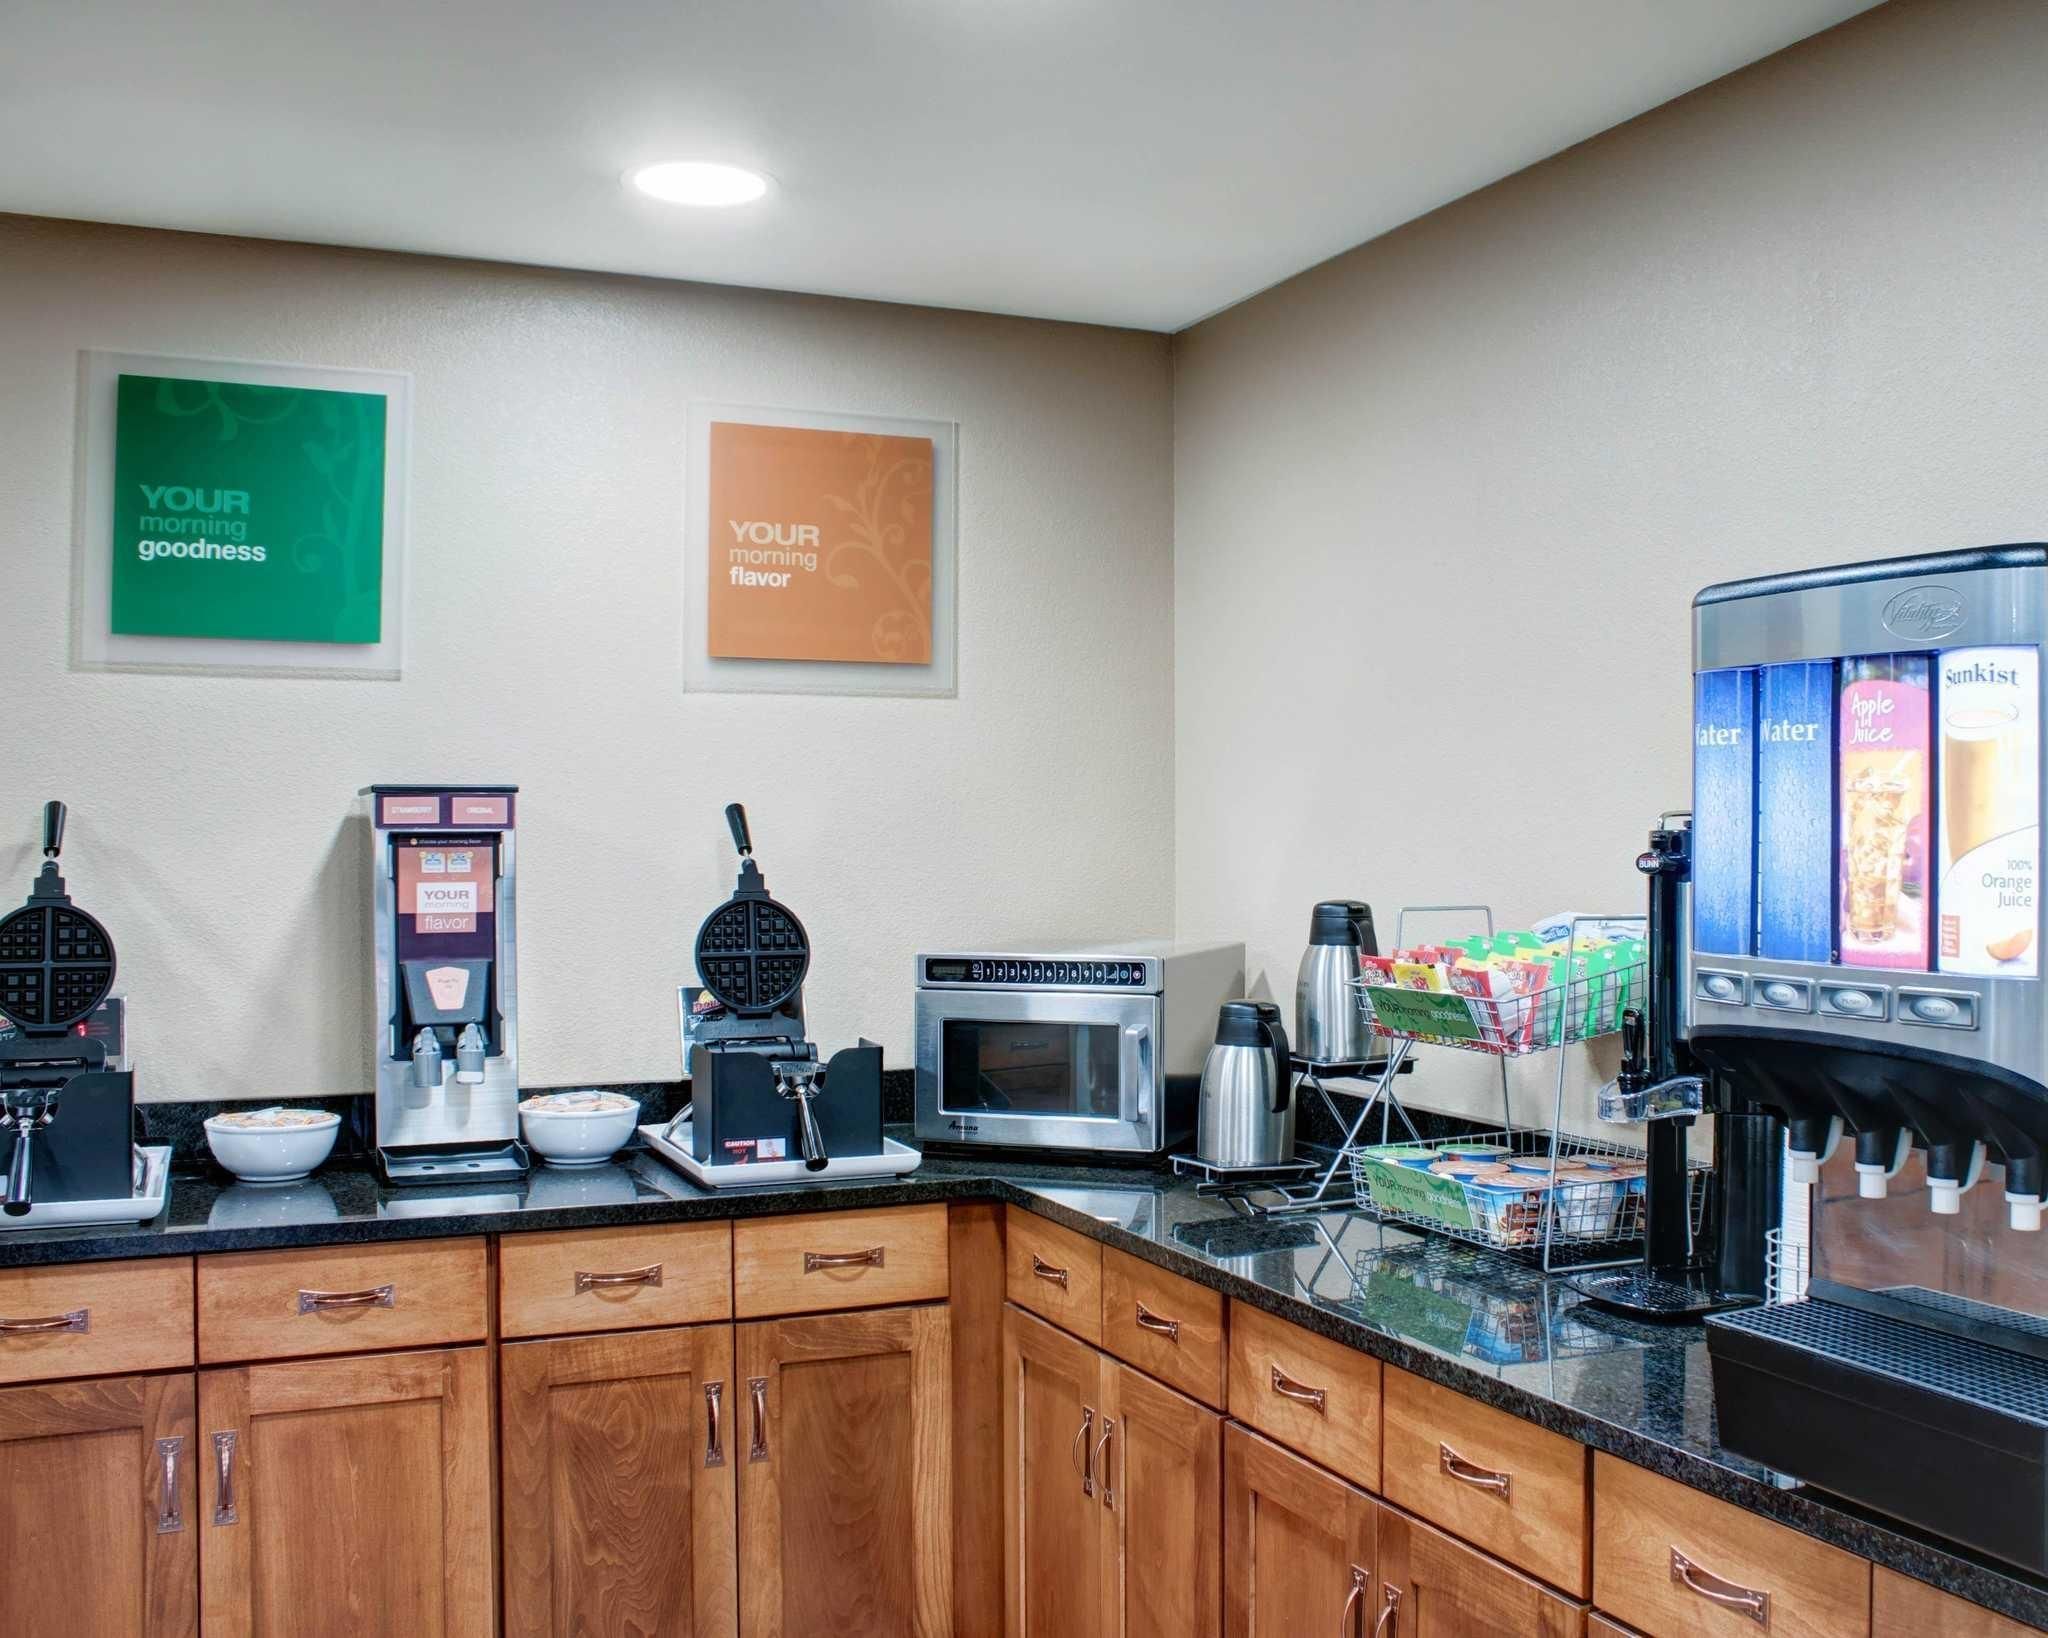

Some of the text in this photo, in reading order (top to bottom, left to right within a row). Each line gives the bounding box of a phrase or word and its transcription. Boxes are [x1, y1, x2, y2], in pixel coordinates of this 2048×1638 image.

[139, 484, 250, 514] YOUR
[139, 515, 248, 542] morning
[728, 519, 820, 547] YOUR
[138, 538, 267, 562] goodness
[729, 546, 818, 572] morning
[729, 565, 792, 588] flavor
[1945, 661, 2020, 688] Sunkist
[1851, 689, 1895, 728] Apple
[1849, 719, 1894, 745] Juice
[1638, 858, 1660, 869] BUNN
[2007, 859, 2033, 871] 100%
[1981, 872, 2033, 893] Orange
[424, 889, 470, 901] YOUR
[424, 901, 470, 911] morning
[1997, 891, 2032, 909] Juice
[424, 914, 469, 930] flavor
[985, 967, 991, 976] 1
[997, 968, 1004, 976] 2
[1009, 968, 1016, 976] 3
[1021, 968, 1028, 977] 4
[1034, 969, 1040, 977] 5
[1046, 969, 1052, 977] 6
[1058, 969, 1065, 977] 7
[1071, 969, 1077, 978] 8
[1083, 970, 1090, 978] 9
[1379, 998, 1402, 1014] YOUR
[724, 1139, 756, 1148] CAUTION
[1374, 1175, 1397, 1190] YOUR
[1397, 1183, 1426, 1201] morning
